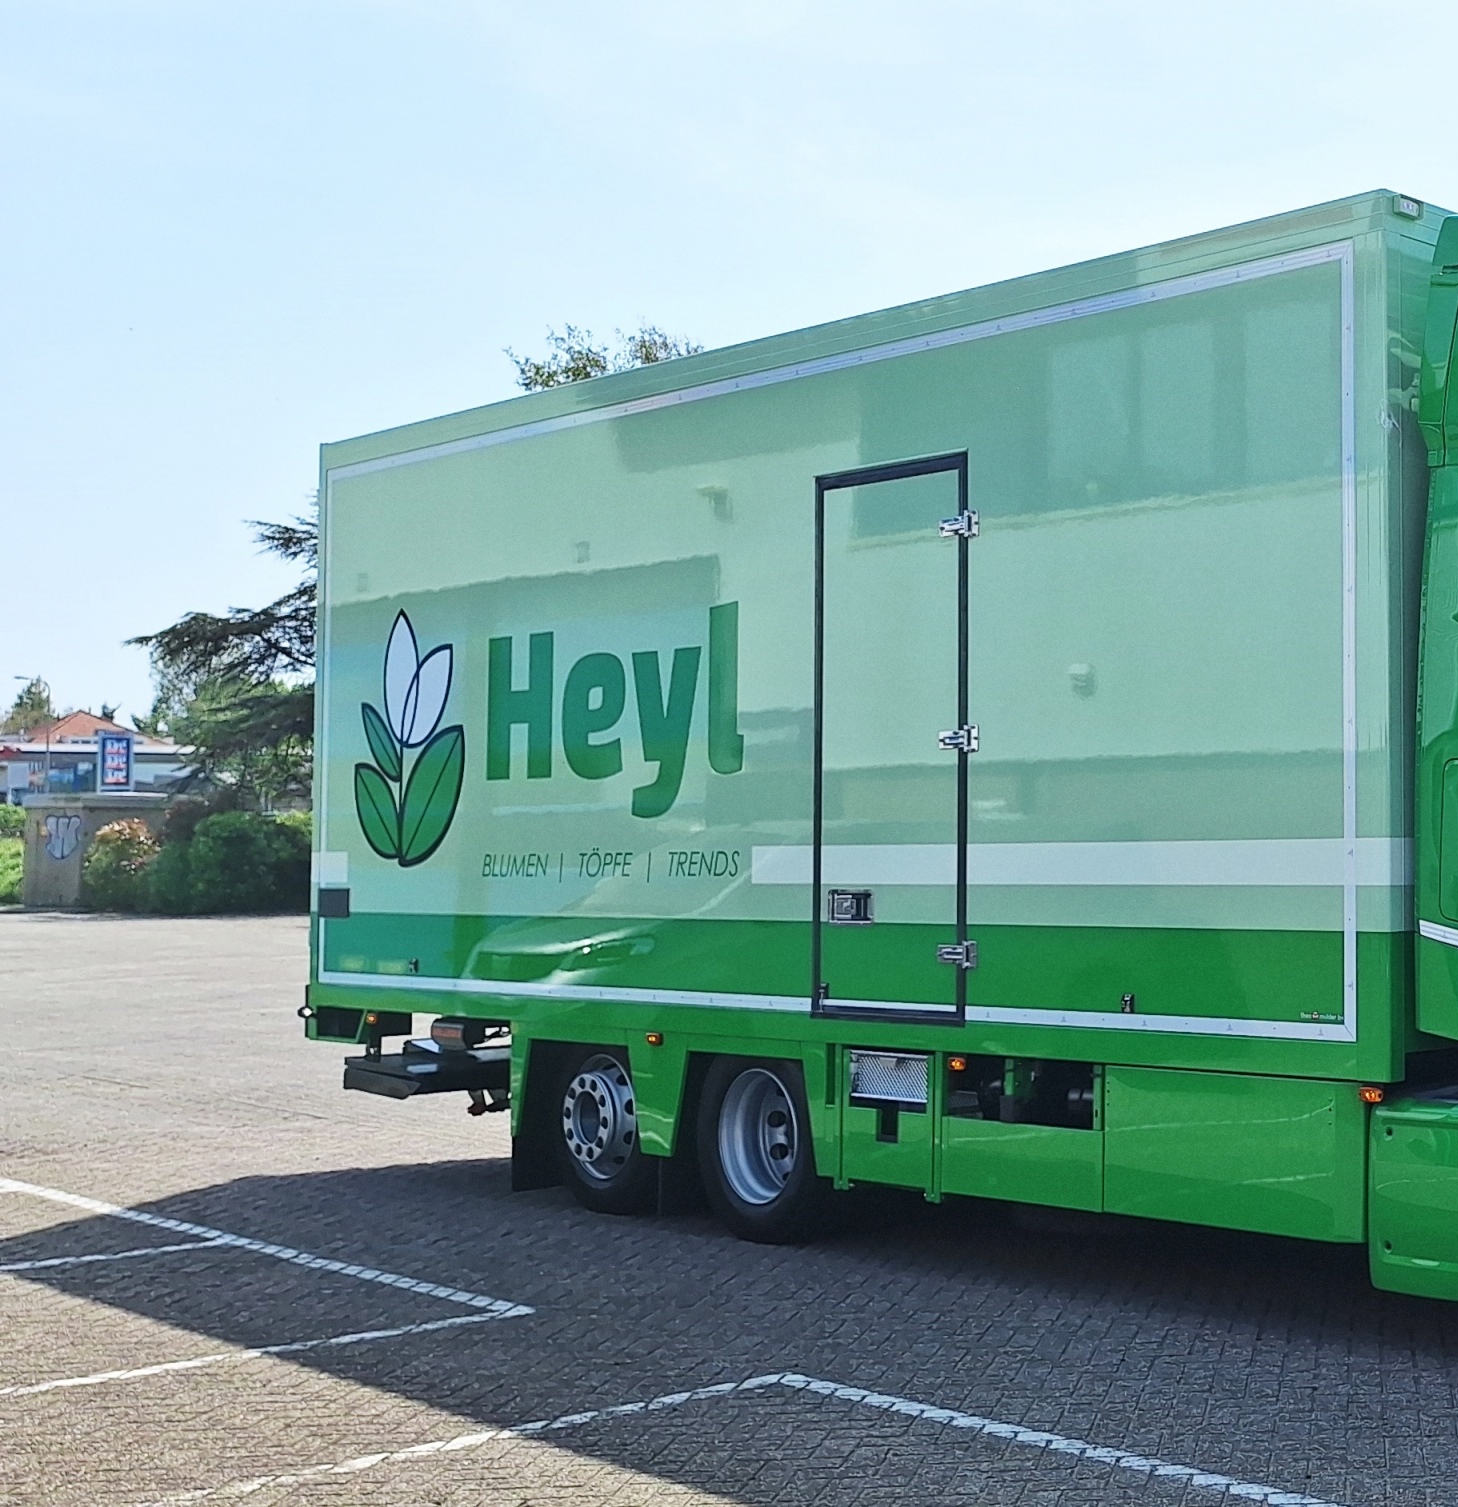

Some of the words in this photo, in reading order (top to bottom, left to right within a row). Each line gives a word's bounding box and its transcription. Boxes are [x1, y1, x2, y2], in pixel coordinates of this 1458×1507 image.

[486, 601, 745, 819] Heyl
[482, 853, 549, 877] BLUMEN
[578, 847, 634, 878] TÖPFE
[667, 850, 740, 877] TRENDS
